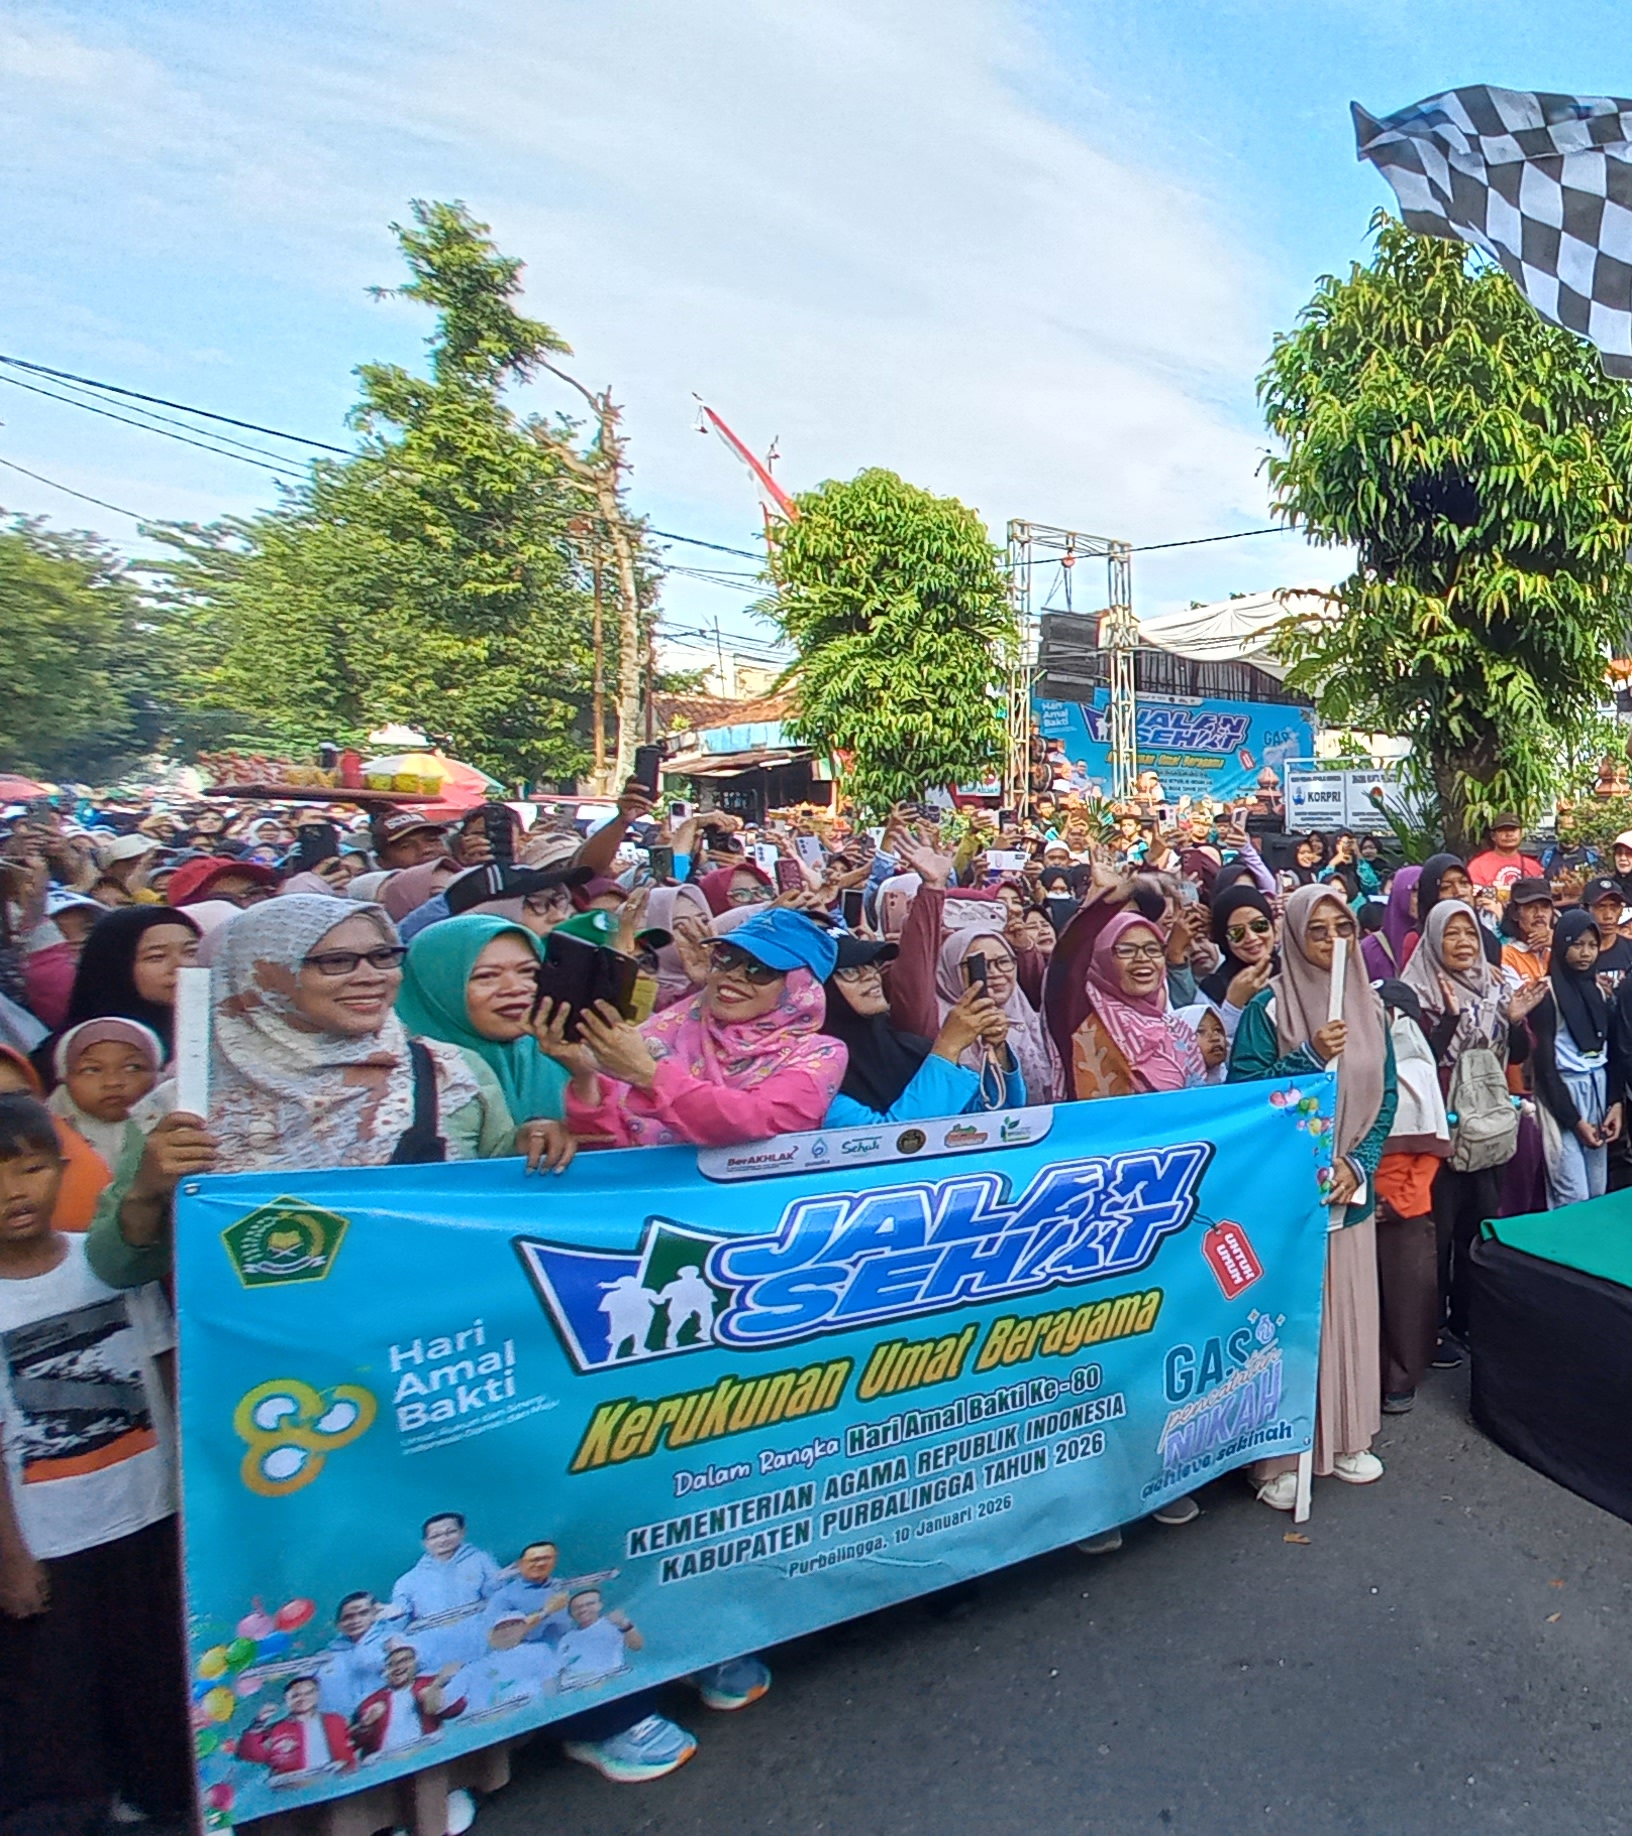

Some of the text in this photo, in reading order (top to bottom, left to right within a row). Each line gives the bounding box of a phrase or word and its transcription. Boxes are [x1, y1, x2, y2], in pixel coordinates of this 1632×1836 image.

[1307, 791, 1341, 803] KORPRI
[726, 1146, 1207, 1277] JALAN
[730, 1202, 1188, 1337] SEHAT
[1216, 1243, 1244, 1285] UMUM
[389, 1318, 486, 1372] Hari
[392, 1339, 516, 1404] Amal
[570, 1289, 1163, 1473] Kerukunan Umat Beragama
[396, 1369, 516, 1432] Bakti
[674, 1463, 751, 1497] Dalam
[758, 1439, 839, 1474] Rangka
[847, 1414, 900, 1456] Hari
[903, 1398, 963, 1440] Amal
[967, 1383, 1025, 1424] Bakti
[1163, 1358, 1283, 1470] NIKAH
[627, 1393, 1126, 1558] KEMENTERIAN AGAMA REPUBLIK INDONESIA
[1141, 1420, 1293, 1499] achieve sakinah
[659, 1519, 811, 1585] KABUPATEN
[819, 1474, 976, 1538] PURBALINGGA
[982, 1450, 1048, 1488] TAHUN
[1053, 1430, 1106, 1467] 2026
[894, 1527, 911, 1548] 10
[915, 1510, 973, 1538] Januari
[977, 1494, 1013, 1521] 2026
